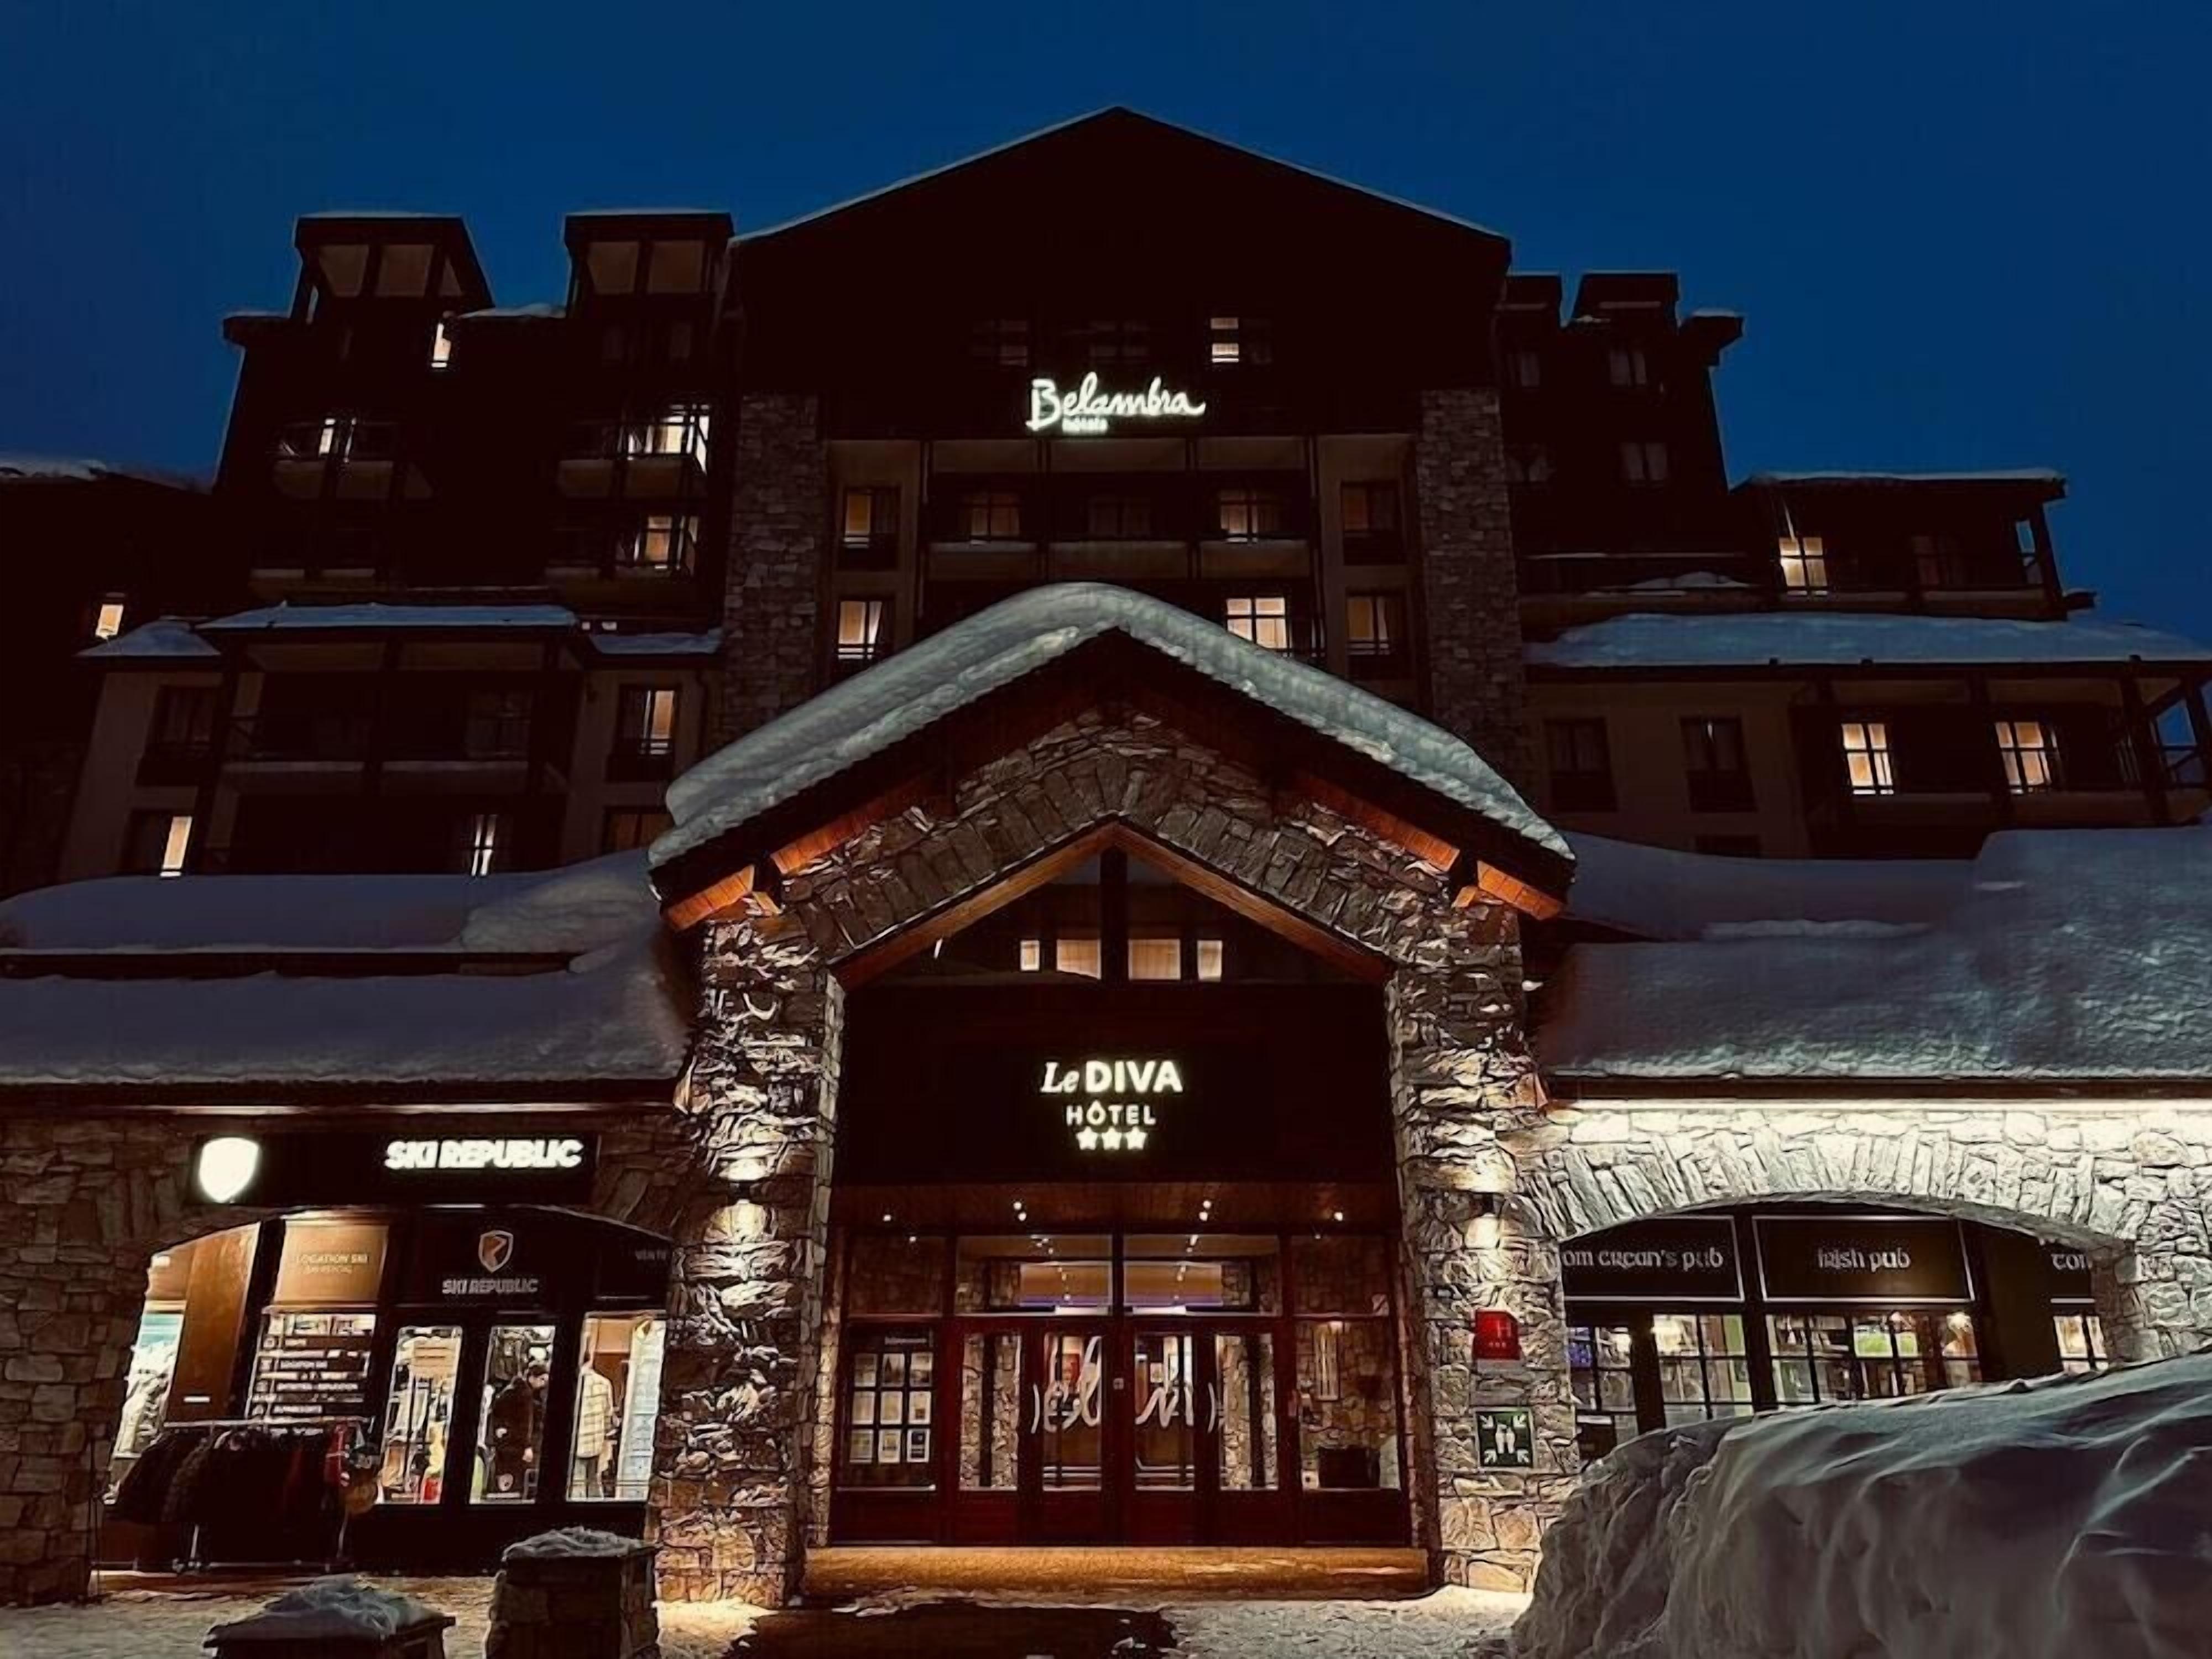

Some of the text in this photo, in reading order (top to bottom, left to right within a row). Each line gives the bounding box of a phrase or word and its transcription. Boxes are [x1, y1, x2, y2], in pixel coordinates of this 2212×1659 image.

[1025, 371, 1206, 431] Belambra
[1040, 1060, 1183, 1093] Le DIVA
[1066, 1099, 1157, 1126] HÔTEL
[385, 1139, 583, 1170] SKI REPUBLIC
[1562, 1251, 1594, 1266] om
[442, 1277, 538, 1294] SKI REPUBLIC
